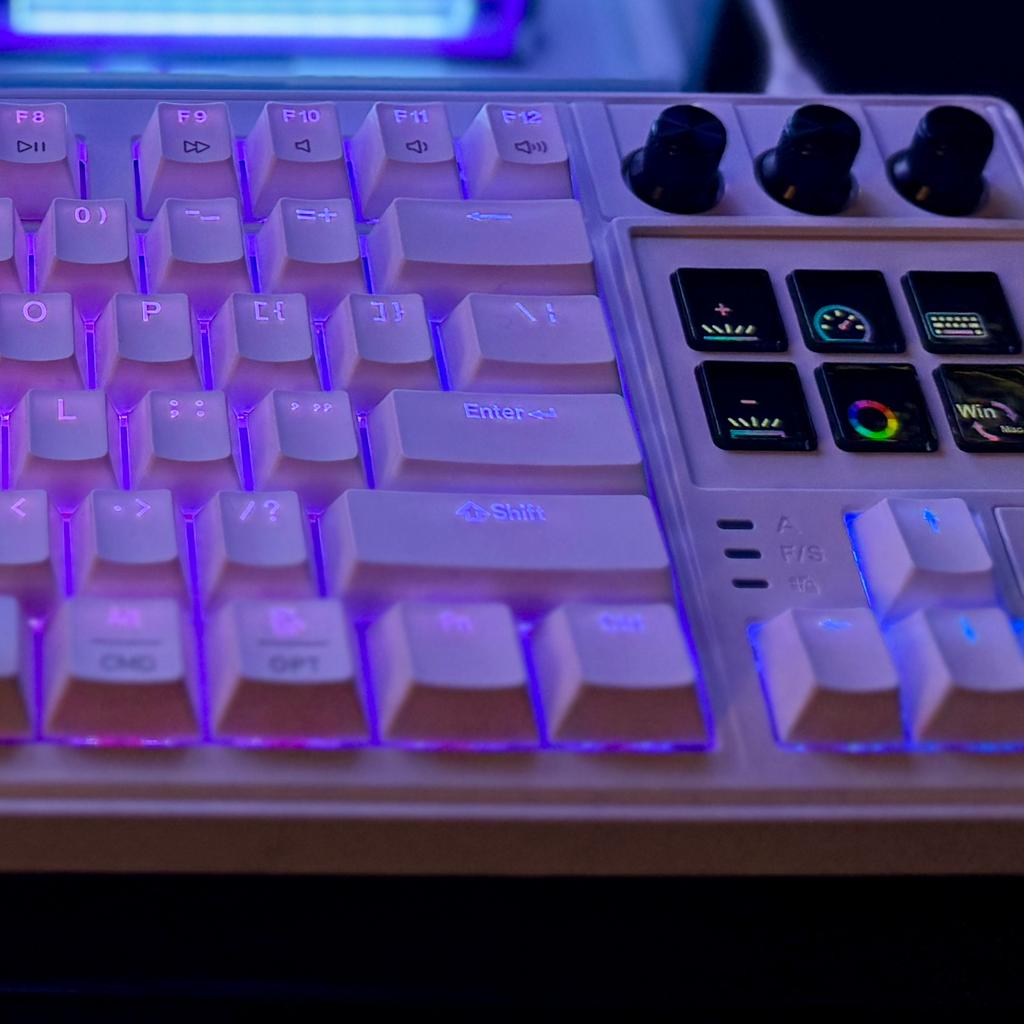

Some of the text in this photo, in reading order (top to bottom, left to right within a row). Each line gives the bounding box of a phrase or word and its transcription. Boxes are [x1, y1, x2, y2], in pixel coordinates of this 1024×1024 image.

[16, 110, 45, 123] F8
[178, 110, 208, 123] F9
[283, 109, 321, 123] F10
[394, 110, 429, 124] F11
[502, 110, 542, 124] F12
[23, 301, 47, 322] O
[142, 301, 162, 322] P
[58, 399, 76, 420] L
[464, 403, 524, 420] Enter
[956, 403, 996, 418] Win
[491, 503, 546, 521] Shift
